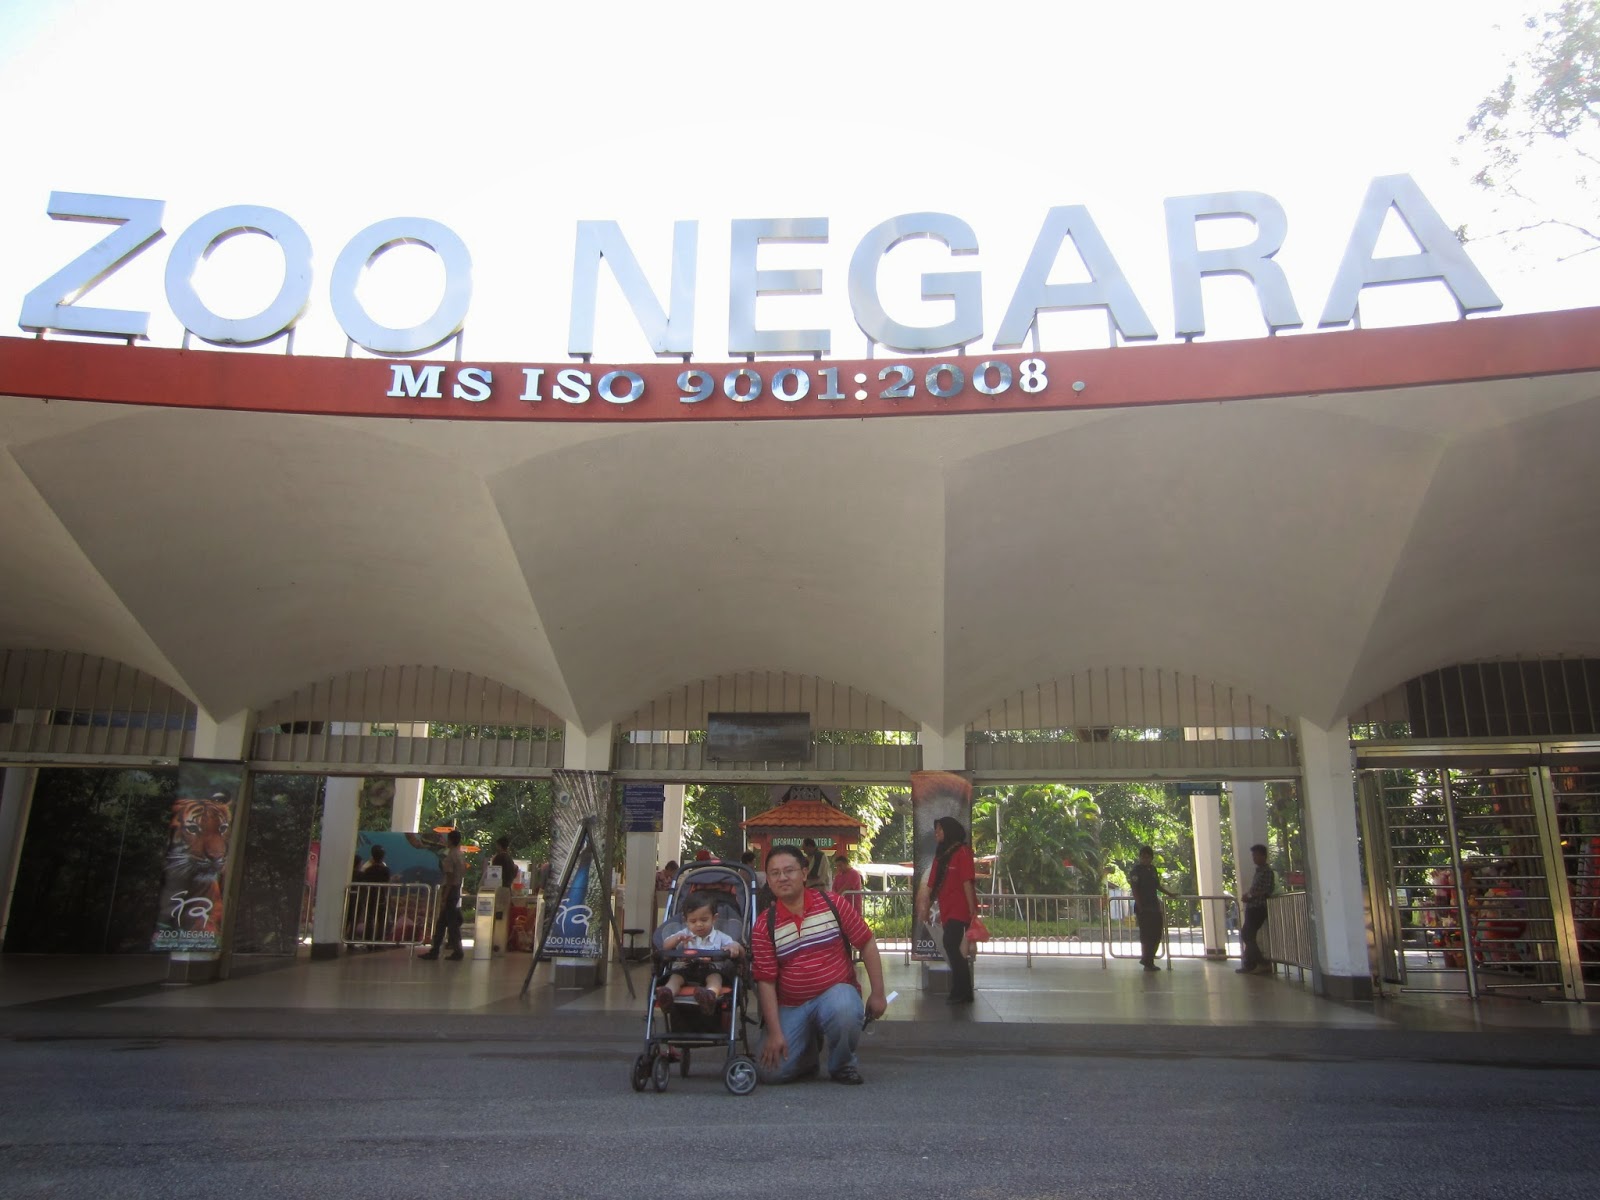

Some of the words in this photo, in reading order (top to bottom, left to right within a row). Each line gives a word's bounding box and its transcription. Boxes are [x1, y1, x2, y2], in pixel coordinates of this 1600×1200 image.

[19, 190, 472, 357] ZOO
[568, 173, 1504, 358] NEGARA
[387, 364, 493, 402] MS
[519, 368, 645, 404] ISO
[676, 358, 1049, 403] 9001:2008
[158, 930, 179, 938] ZOO
[179, 930, 215, 938] NEGARA
[545, 936, 564, 945] ZOO
[564, 937, 597, 945] NEGARA
[916, 940, 935, 948] ZOO
